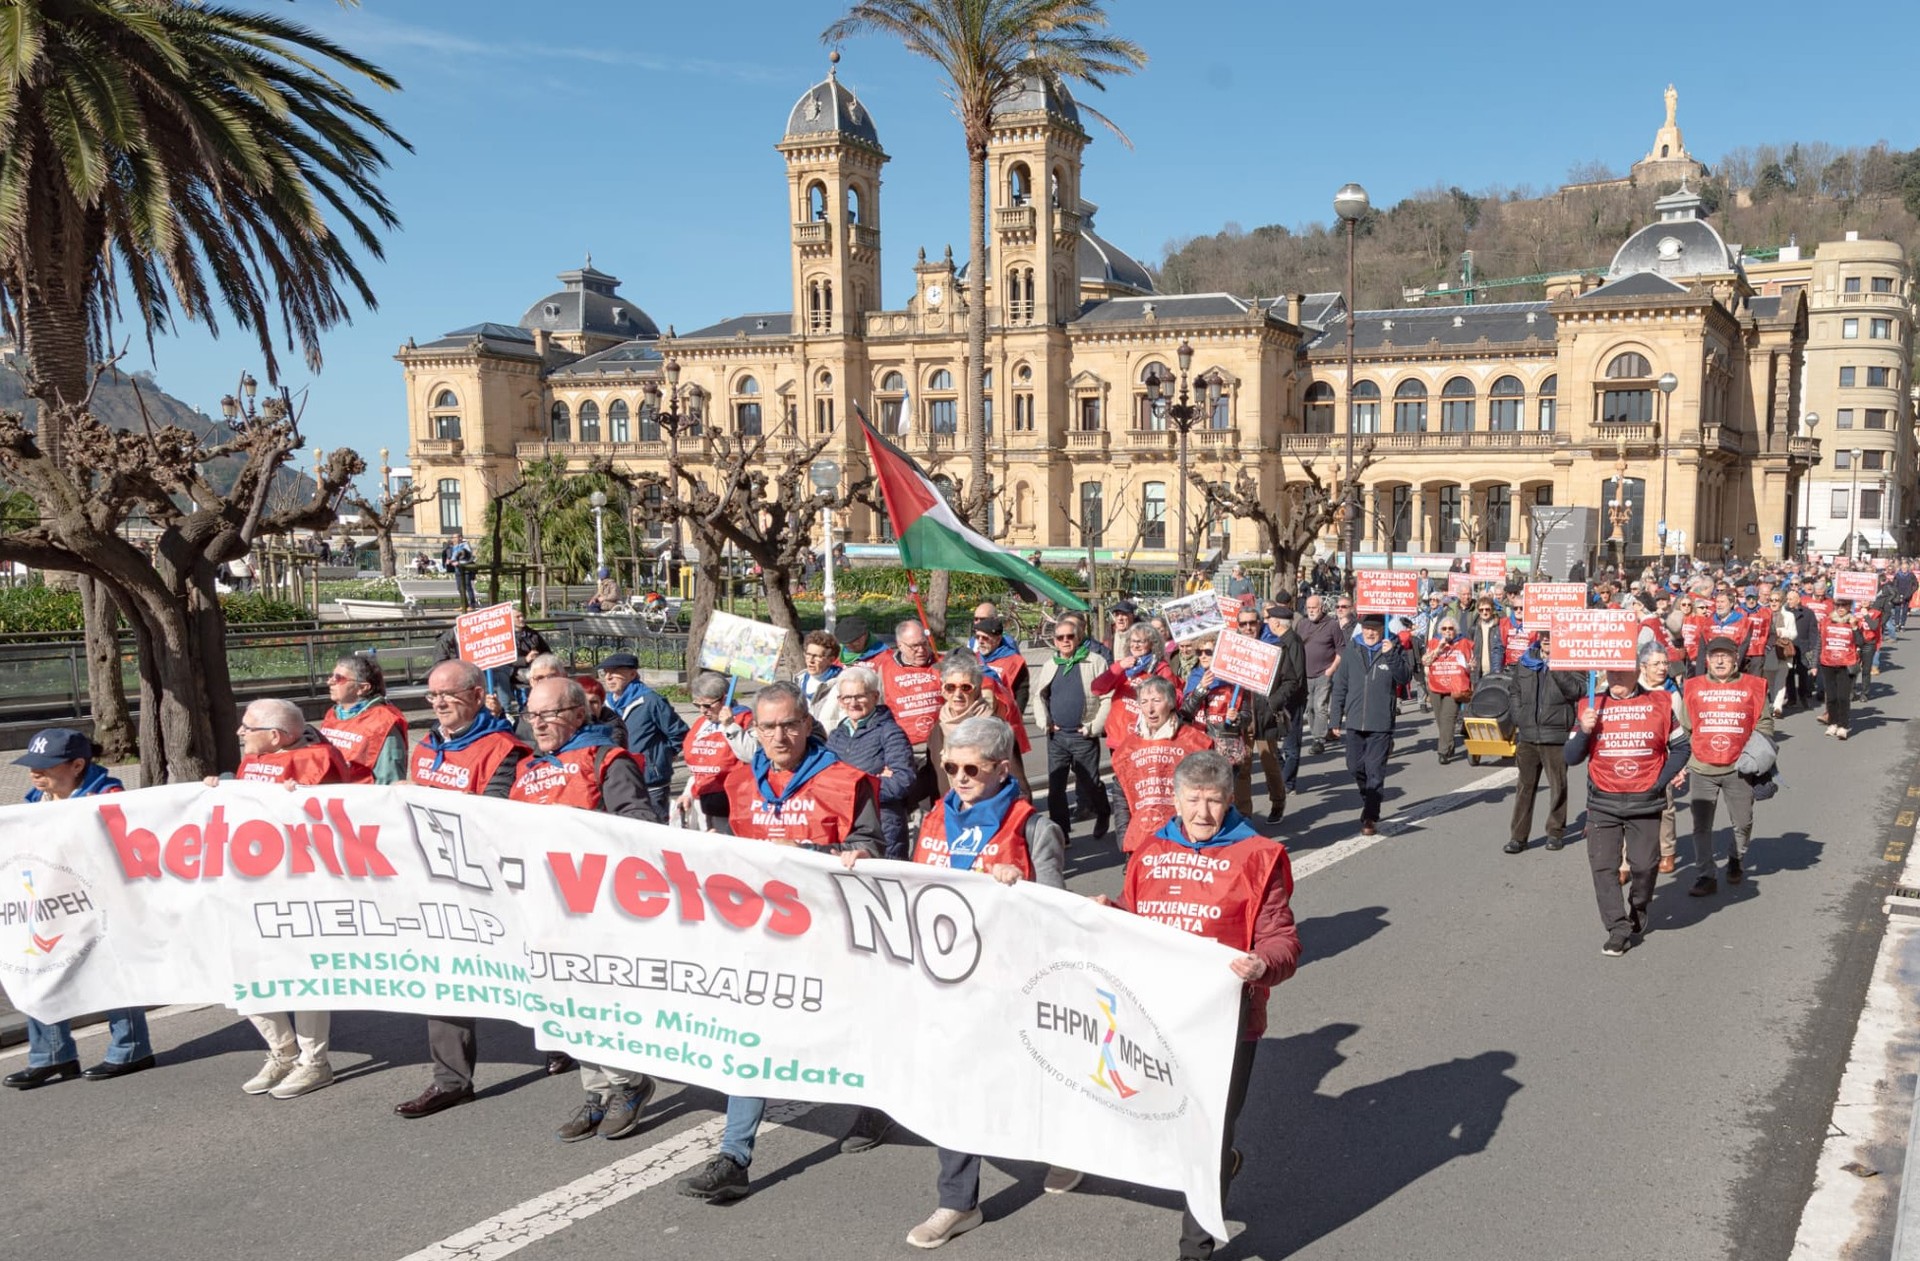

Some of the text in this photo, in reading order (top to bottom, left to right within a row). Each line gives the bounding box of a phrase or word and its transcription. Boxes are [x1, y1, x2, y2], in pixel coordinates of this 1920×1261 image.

[1528, 585, 1585, 594] GUTXIENEKO
[1556, 612, 1636, 622] GUTXIENEKO
[1569, 623, 1626, 632] PENTSIOA
[1558, 639, 1633, 649] GUTXIENEKO
[1569, 649, 1622, 658] SOLDATA
[1602, 713, 1647, 721] PENTSIOA
[1699, 711, 1746, 719] GUTXIENEKO
[1597, 731, 1654, 741] GUTXIENEKO
[1605, 740, 1646, 748] SOLDATA
[750, 796, 815, 812] PIÓN
[921, 837, 999, 856] GUTKO
[1145, 866, 1214, 883] ENTSIOA
[99, 797, 399, 880] betorik
[546, 850, 812, 936] vetos
[832, 871, 982, 984] NO
[34, 890, 94, 922] MPEH
[1137, 901, 1222, 919] GUTXIENEKO
[254, 900, 506, 945] HEL-ILP
[310, 949, 761, 1048] PENSIÓN MÍNIM Salario Mínimo
[1037, 1001, 1174, 1087] EHPM MPEH
[541, 1019, 713, 1070] Gutxieneko
[722, 1053, 865, 1089] Soldata
[1019, 1029, 1064, 1082] MOVIMIENTO
